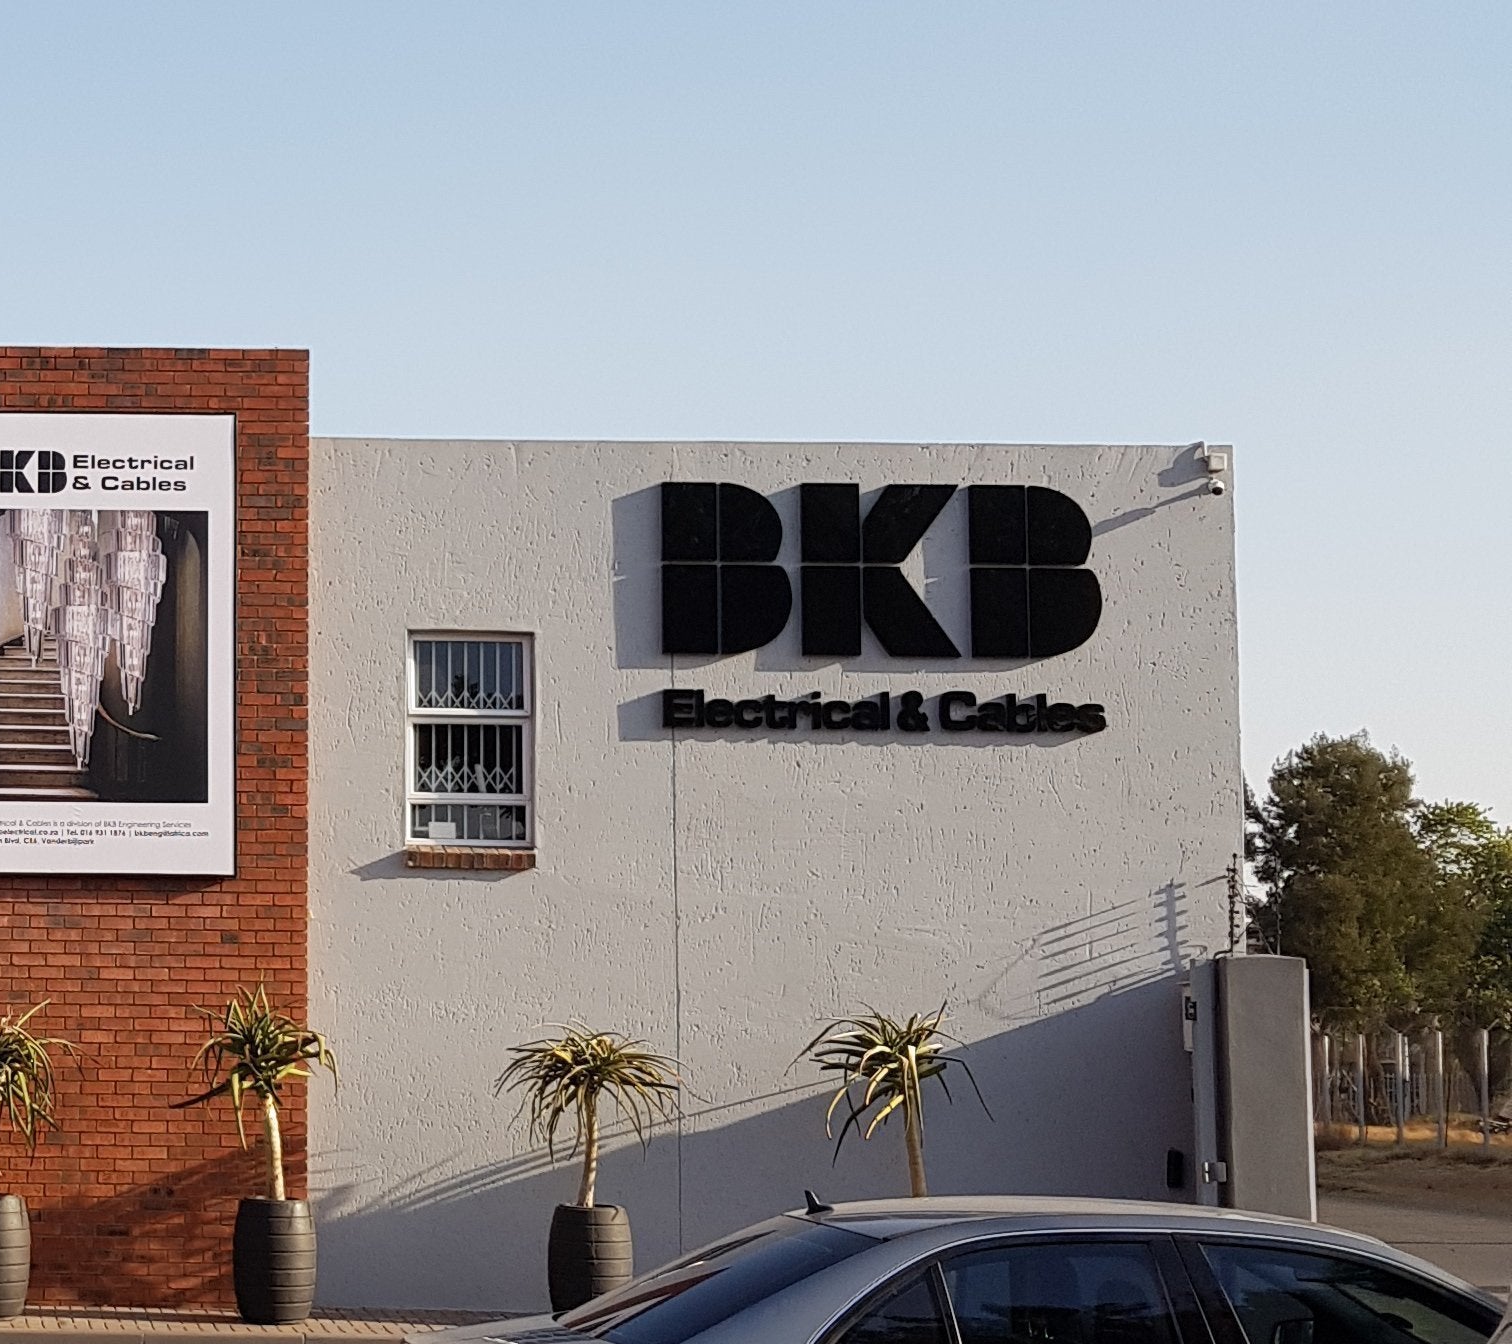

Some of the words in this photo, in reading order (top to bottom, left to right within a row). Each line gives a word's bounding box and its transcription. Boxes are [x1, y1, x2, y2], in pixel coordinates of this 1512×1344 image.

[72, 454, 195, 470] Electrical
[72, 475, 91, 491] &
[100, 475, 187, 491] Cables
[661, 481, 1103, 658] BKB
[662, 689, 890, 732] Electrical
[897, 690, 930, 733] &
[939, 691, 1107, 734] Cables
[119, 820, 160, 829] Engineering
[162, 820, 192, 828] Services
